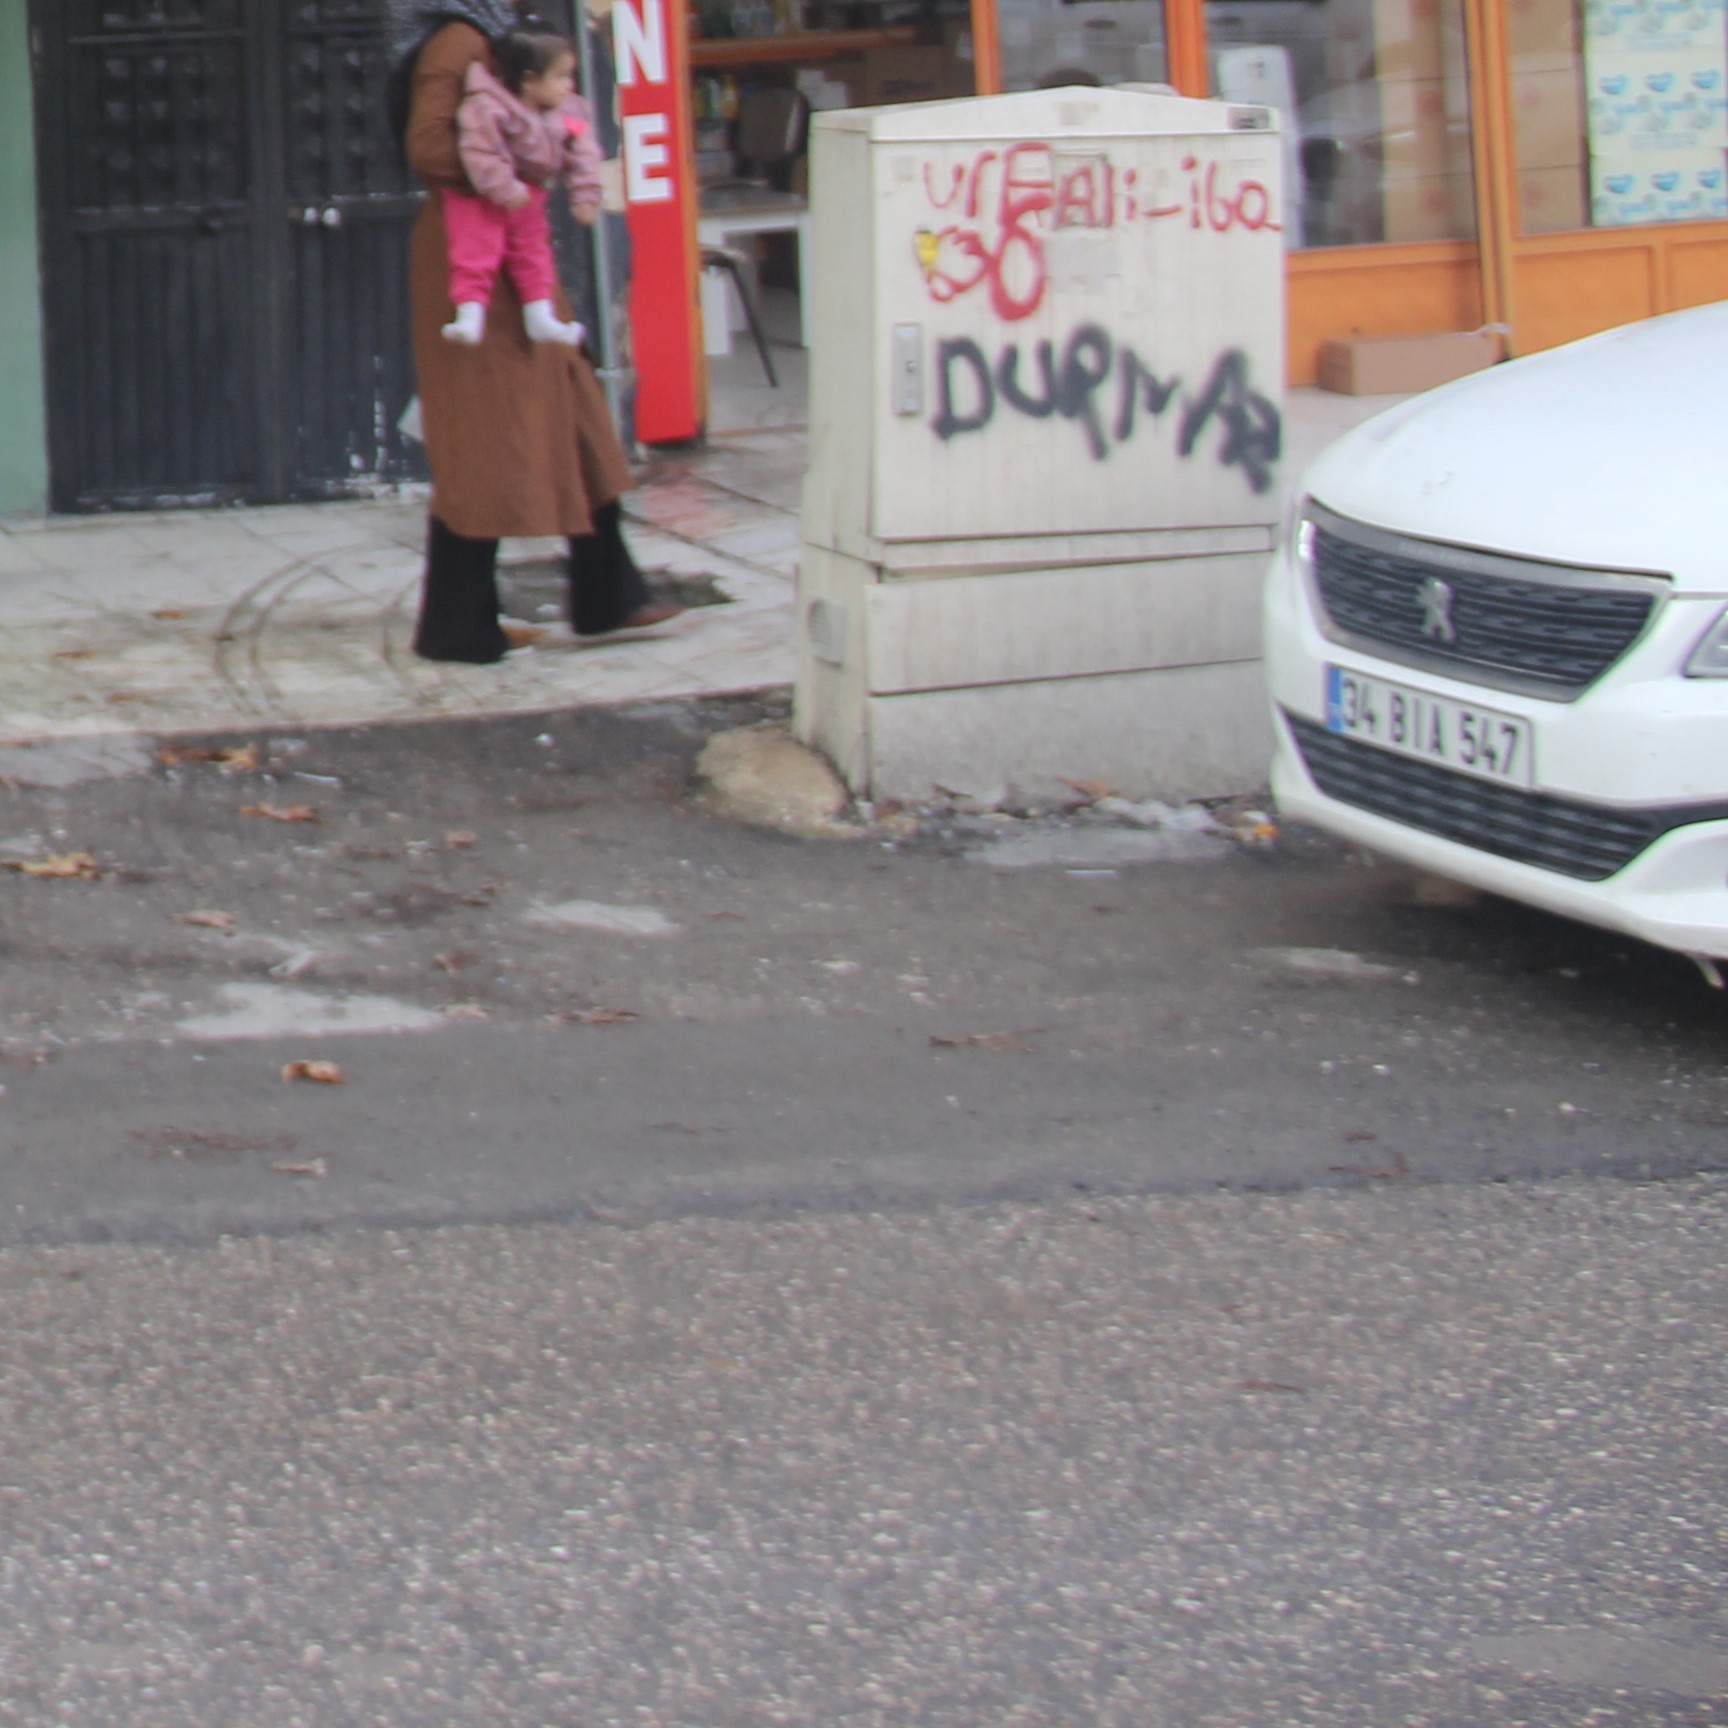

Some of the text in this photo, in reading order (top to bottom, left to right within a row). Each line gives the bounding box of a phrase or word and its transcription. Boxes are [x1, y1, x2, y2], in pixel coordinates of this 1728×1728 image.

[1343, 677, 1518, 775] 34 BIA 547
